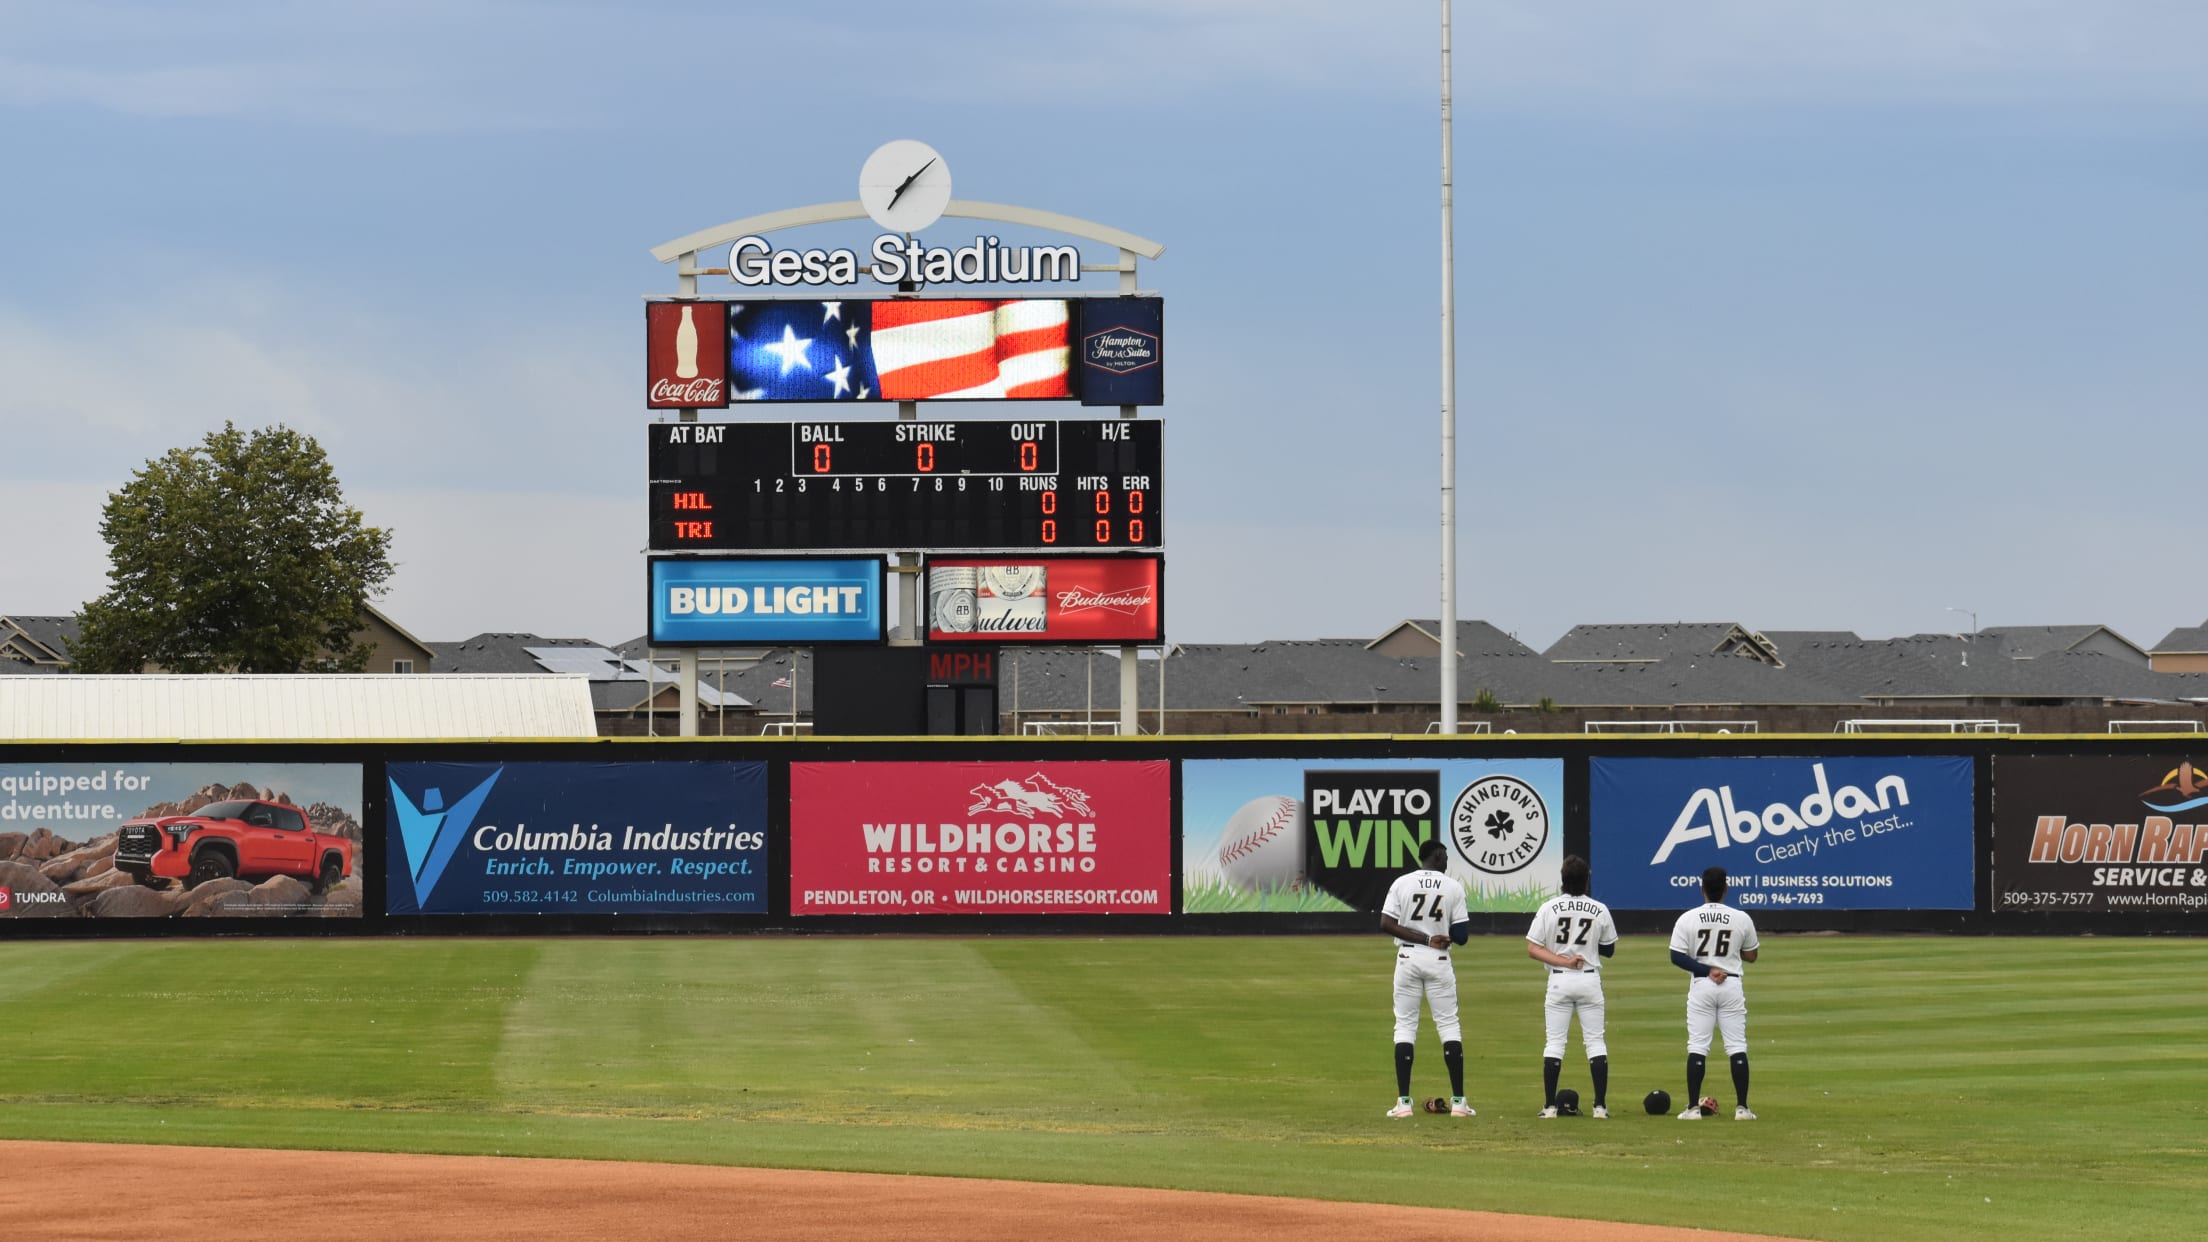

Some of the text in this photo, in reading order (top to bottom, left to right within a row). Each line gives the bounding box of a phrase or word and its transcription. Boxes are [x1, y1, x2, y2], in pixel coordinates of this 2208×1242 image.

[728, 234, 1081, 286] Gesa Stadium
[1094, 335, 1146, 348] Hampton
[1091, 347, 1117, 359] Inn
[1123, 347, 1151, 358] Suites
[669, 426, 726, 444] AT BAT
[801, 424, 844, 442] BALL
[895, 424, 956, 442] STRIKE
[1011, 423, 1046, 441] OUT
[1102, 422, 1131, 442] H/E
[814, 444, 831, 473] 0
[917, 443, 934, 472] 0
[1020, 442, 1037, 471] 0
[754, 477, 1004, 492] 1 2 3 4 5 6 7 8 9 10
[1019, 476, 1058, 491] RUNS
[1077, 476, 1109, 491] HITS
[1122, 476, 1150, 490] ERR
[674, 491, 1143, 514] HIL 0 0 0
[675, 519, 1143, 543] TRI 0 0 0
[670, 587, 748, 614] BUD
[1056, 591, 1150, 608] Budweiser
[930, 653, 991, 679] MPH
[0, 770, 151, 796] quipped for
[0, 799, 122, 820] dventure.
[1312, 788, 1431, 815] PLAY TO
[1459, 784, 1539, 849] WASHINGTON'S
[1650, 762, 1910, 865] Abadan
[473, 823, 764, 851] Columbia Industries
[863, 823, 1097, 853] WILDHORSE
[1314, 820, 1431, 868] WIN
[1755, 814, 1914, 864] Clearly the best...
[2028, 815, 2140, 863] HORN
[1480, 832, 1538, 866] LOTTERY
[486, 857, 753, 880] Enrich. Empower. Respect.
[869, 858, 1096, 873] RESORT & CASINO
[1419, 879, 1442, 889] YON
[1725, 876, 1751, 887] RINT
[1762, 876, 1818, 887] BUSINESS
[1822, 876, 1893, 887] SOLUTIONS
[2092, 868, 2208, 886] SERVICE &
[15, 892, 66, 904] TUNDRA
[483, 889, 755, 903] 509.582.4142 ColumbiaIndustries.com
[804, 890, 1158, 907] PENDLETON, OR WILDHORSERESORT.COM
[1739, 893, 1824, 906] (509) 946-7693
[2003, 892, 2208, 908] 509-375-7577 www.HornRapi
[1411, 893, 1444, 921] 24
[1552, 901, 1603, 917] PEABODY
[1699, 912, 1731, 925] RIVAS
[1555, 917, 1594, 945] 32
[1696, 929, 1732, 957] 26
